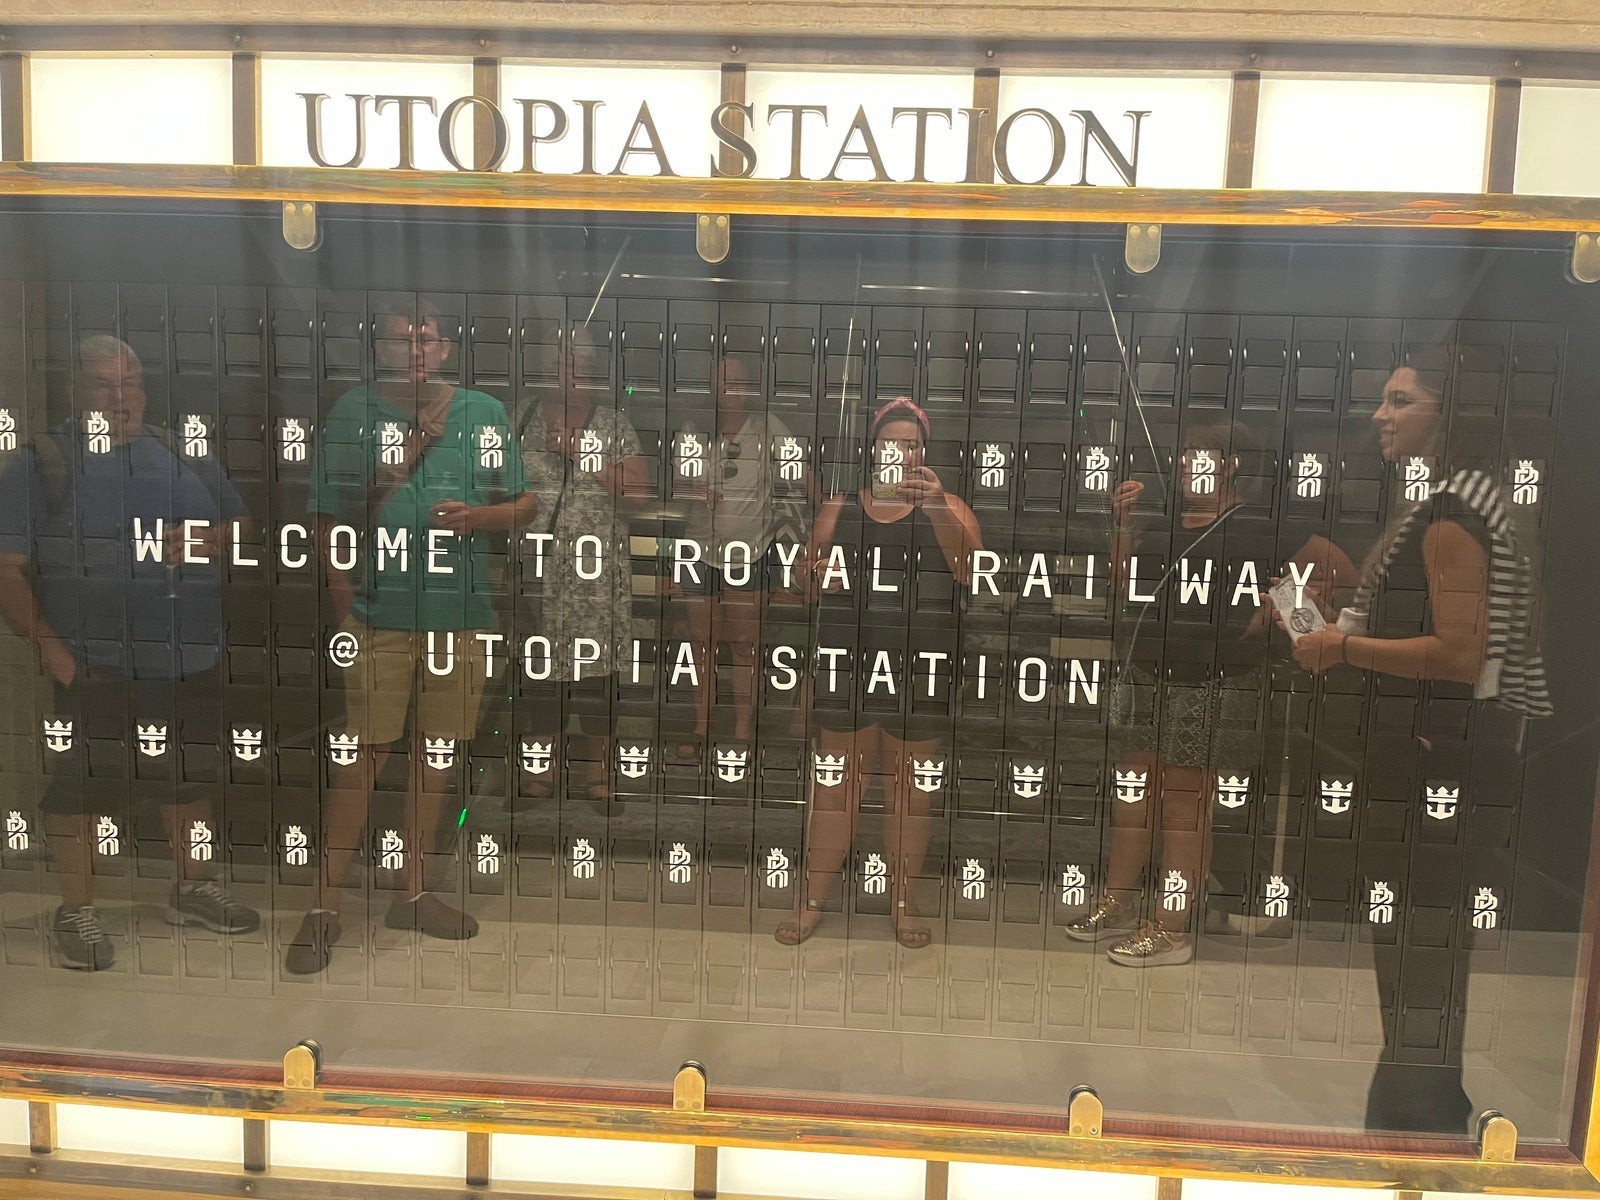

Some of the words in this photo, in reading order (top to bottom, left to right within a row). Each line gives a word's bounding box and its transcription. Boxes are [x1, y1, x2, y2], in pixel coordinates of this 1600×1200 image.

[295, 93, 678, 176] UTOPIA
[710, 101, 1152, 187] STATION
[133, 517, 454, 576] WELCOME
[526, 533, 603, 580] TO
[674, 538, 898, 593] ROYAL
[971, 550, 1316, 609] RAILWAY
[329, 631, 359, 668] @
[427, 632, 701, 688] UTOPIA
[769, 645, 1100, 706] STATION
